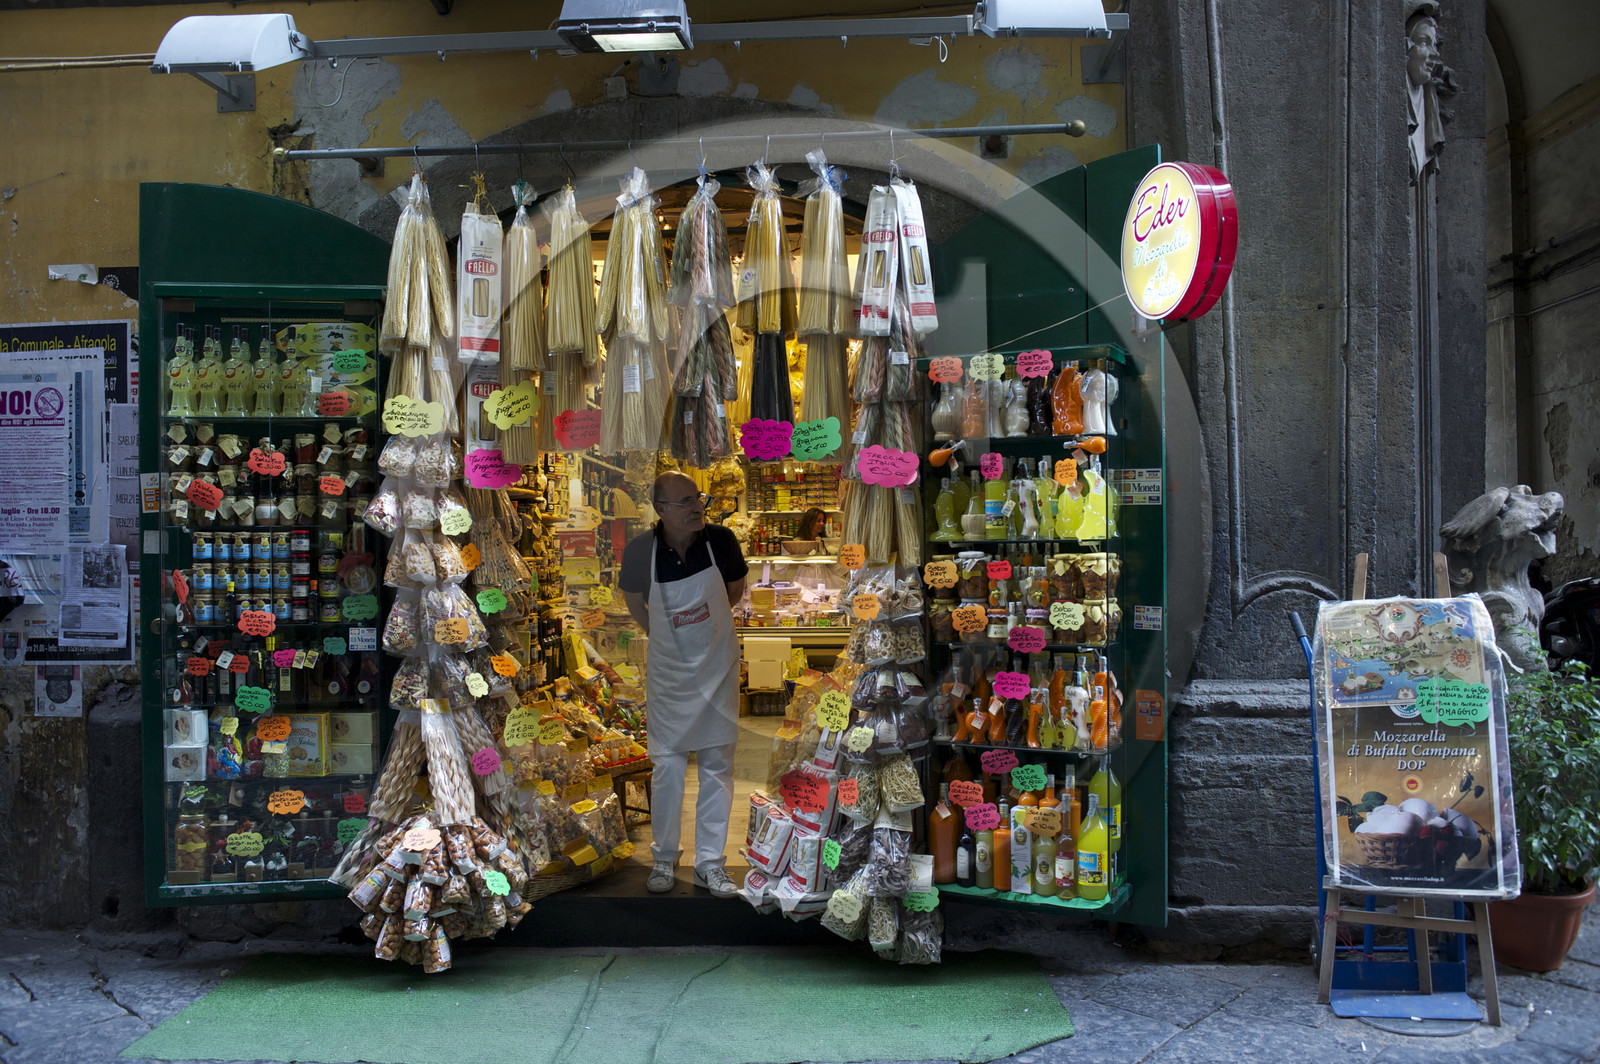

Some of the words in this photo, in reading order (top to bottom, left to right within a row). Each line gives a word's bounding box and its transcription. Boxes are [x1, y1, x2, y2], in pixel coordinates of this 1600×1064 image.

[1132, 183, 1190, 243] Eder
[468, 261, 495, 273] FAELLA
[12, 336, 64, 352] Comunale
[74, 334, 117, 351] Afragola
[1131, 482, 1161, 492] Moneta
[26, 507, 39, 515] Ore
[40, 507, 60, 515] 18.00
[1142, 614, 1161, 622] Moneta
[1438, 708, 1479, 717] OMAGGIO
[1373, 730, 1447, 743] Mozzarella
[1347, 744, 1360, 756] di
[1364, 744, 1407, 759] Bufala
[1411, 744, 1477, 759] Campana
[1397, 759, 1427, 771] DOP
